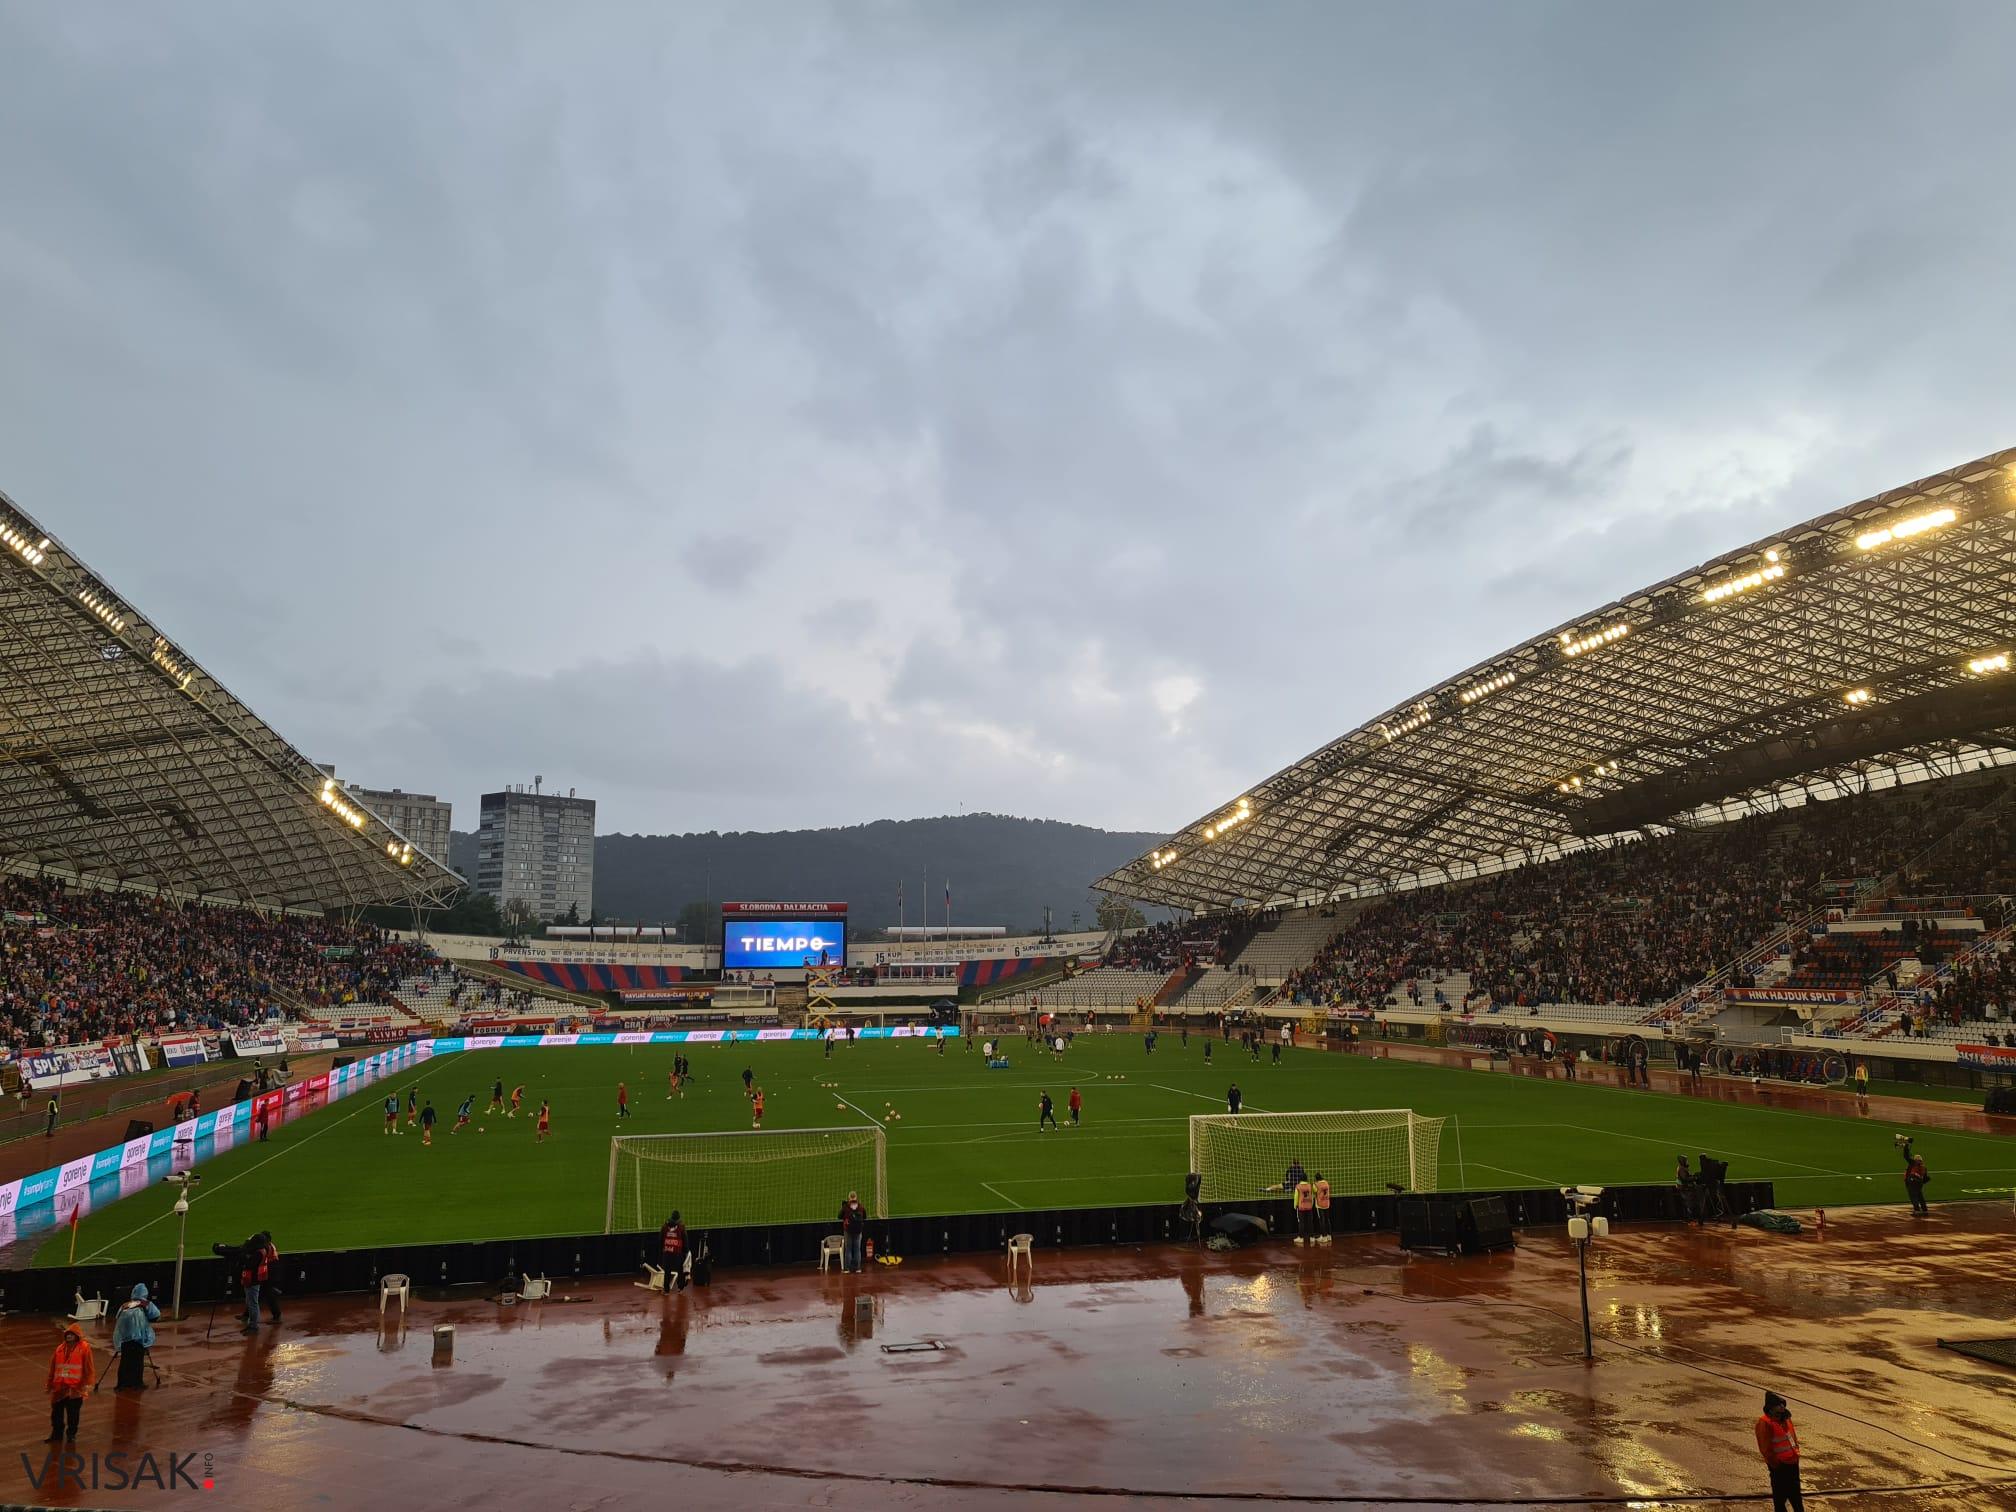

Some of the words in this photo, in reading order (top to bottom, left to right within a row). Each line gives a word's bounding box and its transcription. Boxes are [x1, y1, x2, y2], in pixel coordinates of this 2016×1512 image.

[741, 937, 837, 951] TIEMPO
[489, 948, 499, 959] 18
[1015, 947, 1020, 957] 6
[876, 953, 885, 963] 15
[1748, 991, 1769, 1000] HNK
[1770, 992, 1808, 1001] HAJDUK
[1810, 992, 1837, 1002] SPLIT
[374, 1030, 404, 1039] LIVNO
[547, 1035, 572, 1044] gorenje
[470, 1037, 497, 1047] gorenje
[33, 1056, 66, 1075] SPLIT
[126, 1142, 146, 1162] gorenje
[63, 1161, 87, 1187] gorenje
